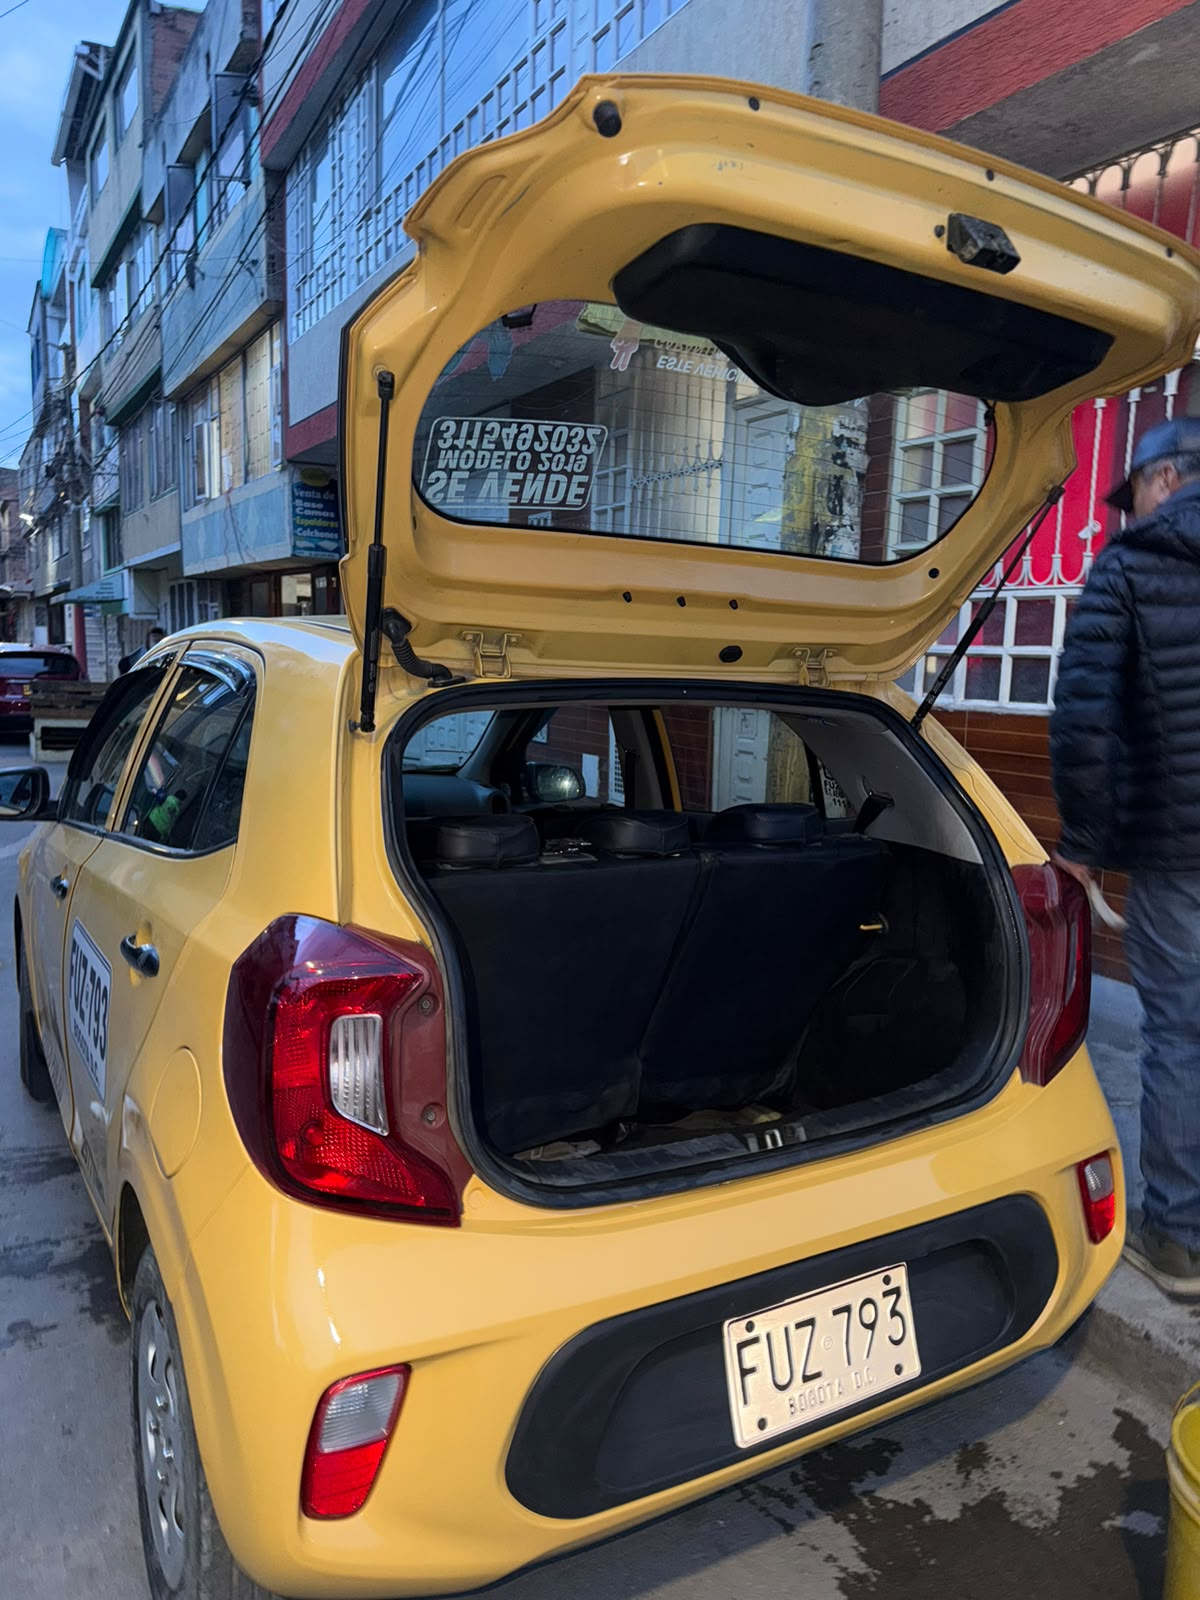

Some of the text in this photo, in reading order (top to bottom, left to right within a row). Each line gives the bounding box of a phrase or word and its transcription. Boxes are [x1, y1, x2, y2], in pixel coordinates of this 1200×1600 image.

[293, 487, 321, 499] Venta
[69, 938, 108, 1062] FUZ 793
[736, 1286, 906, 1406] FUZ 793
[788, 1378, 843, 1416] BOGOTA
